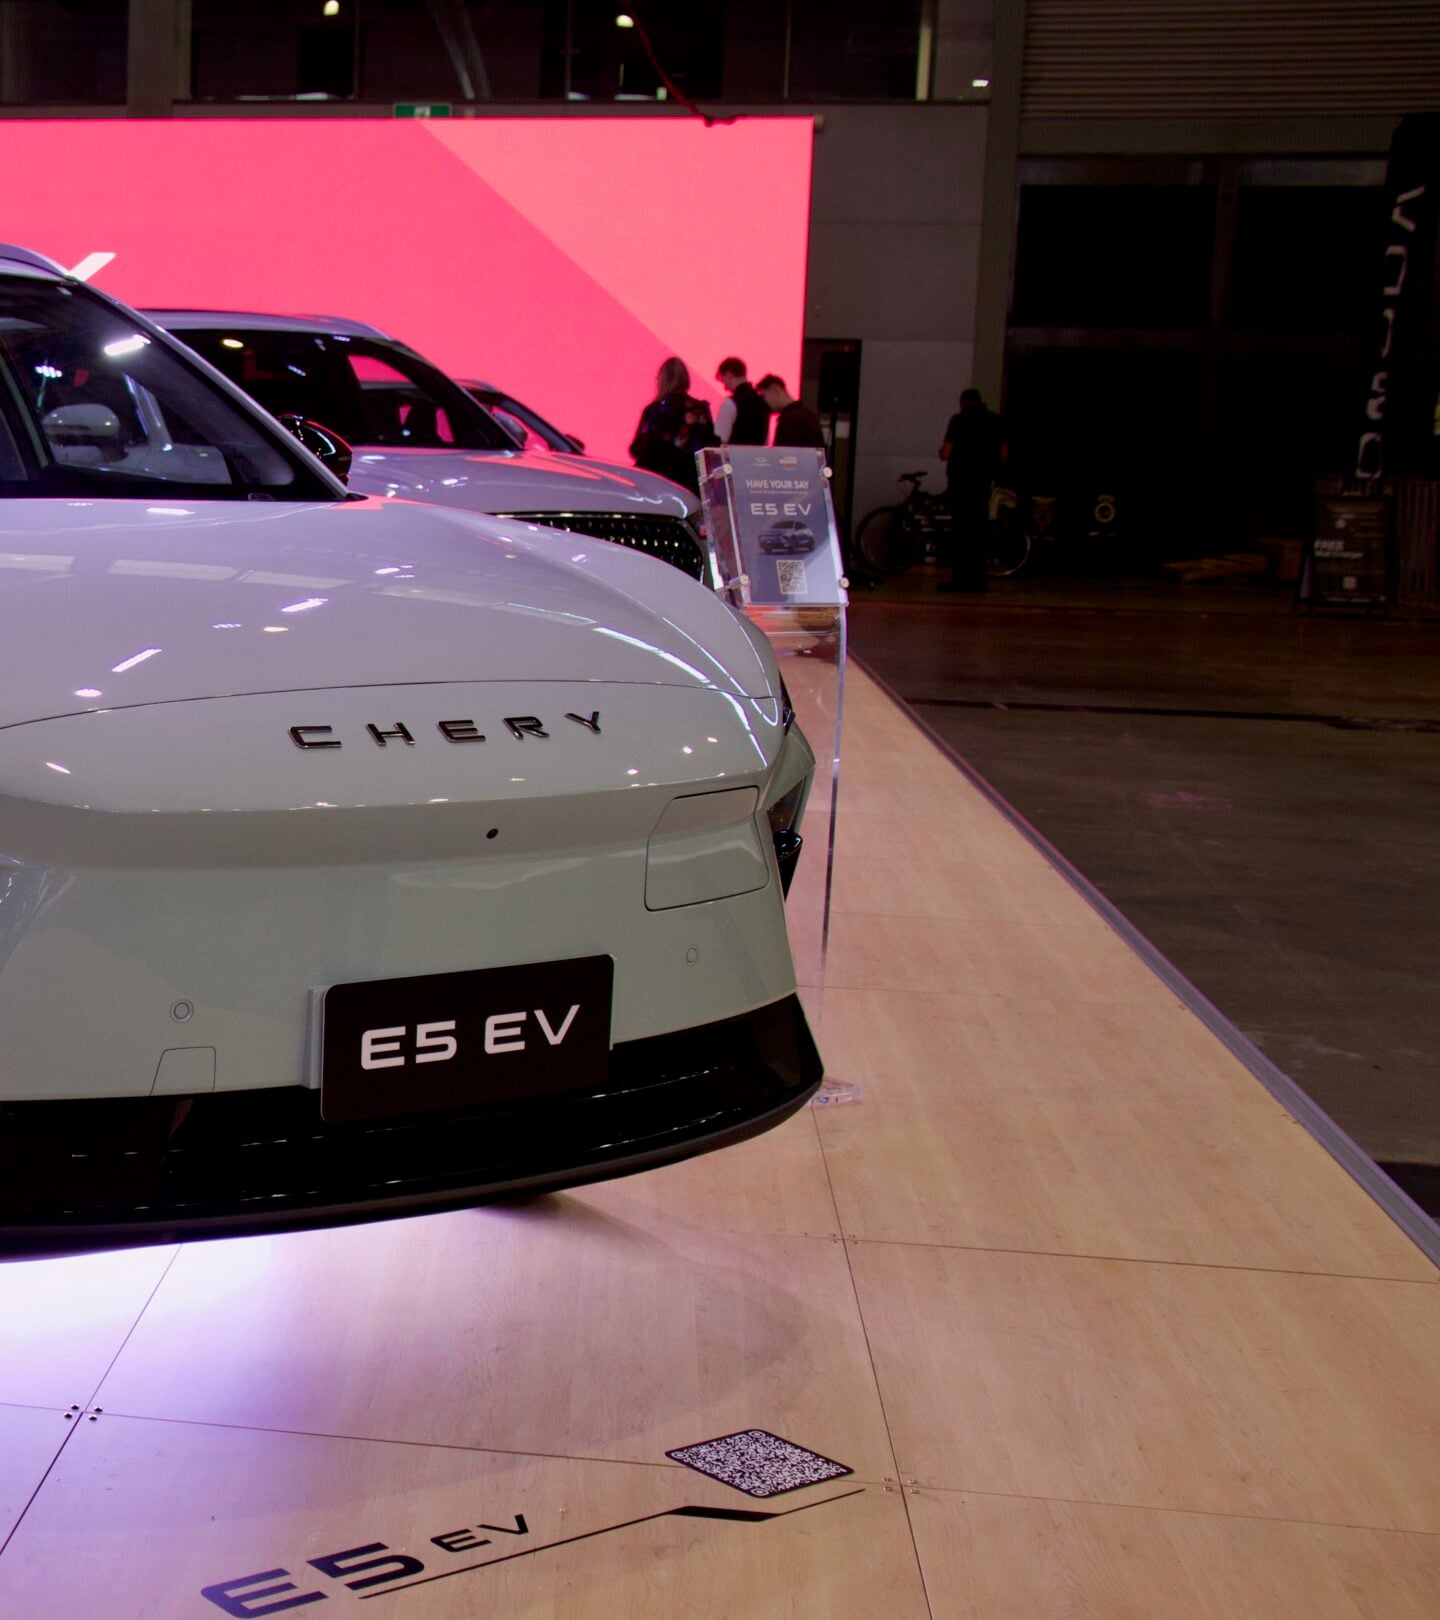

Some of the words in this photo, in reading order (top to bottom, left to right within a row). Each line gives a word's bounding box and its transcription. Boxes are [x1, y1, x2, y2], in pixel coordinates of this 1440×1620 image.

[746, 480, 768, 489] HAVE
[770, 480, 793, 489] YOUR
[794, 480, 810, 489] SAY
[750, 503, 778, 515] E5
[784, 503, 812, 515] EV
[288, 711, 602, 748] CHERY
[361, 1020, 457, 1070] E5
[484, 1004, 580, 1054] EV
[201, 1542, 425, 1619] E5
[430, 1514, 529, 1553] EV
